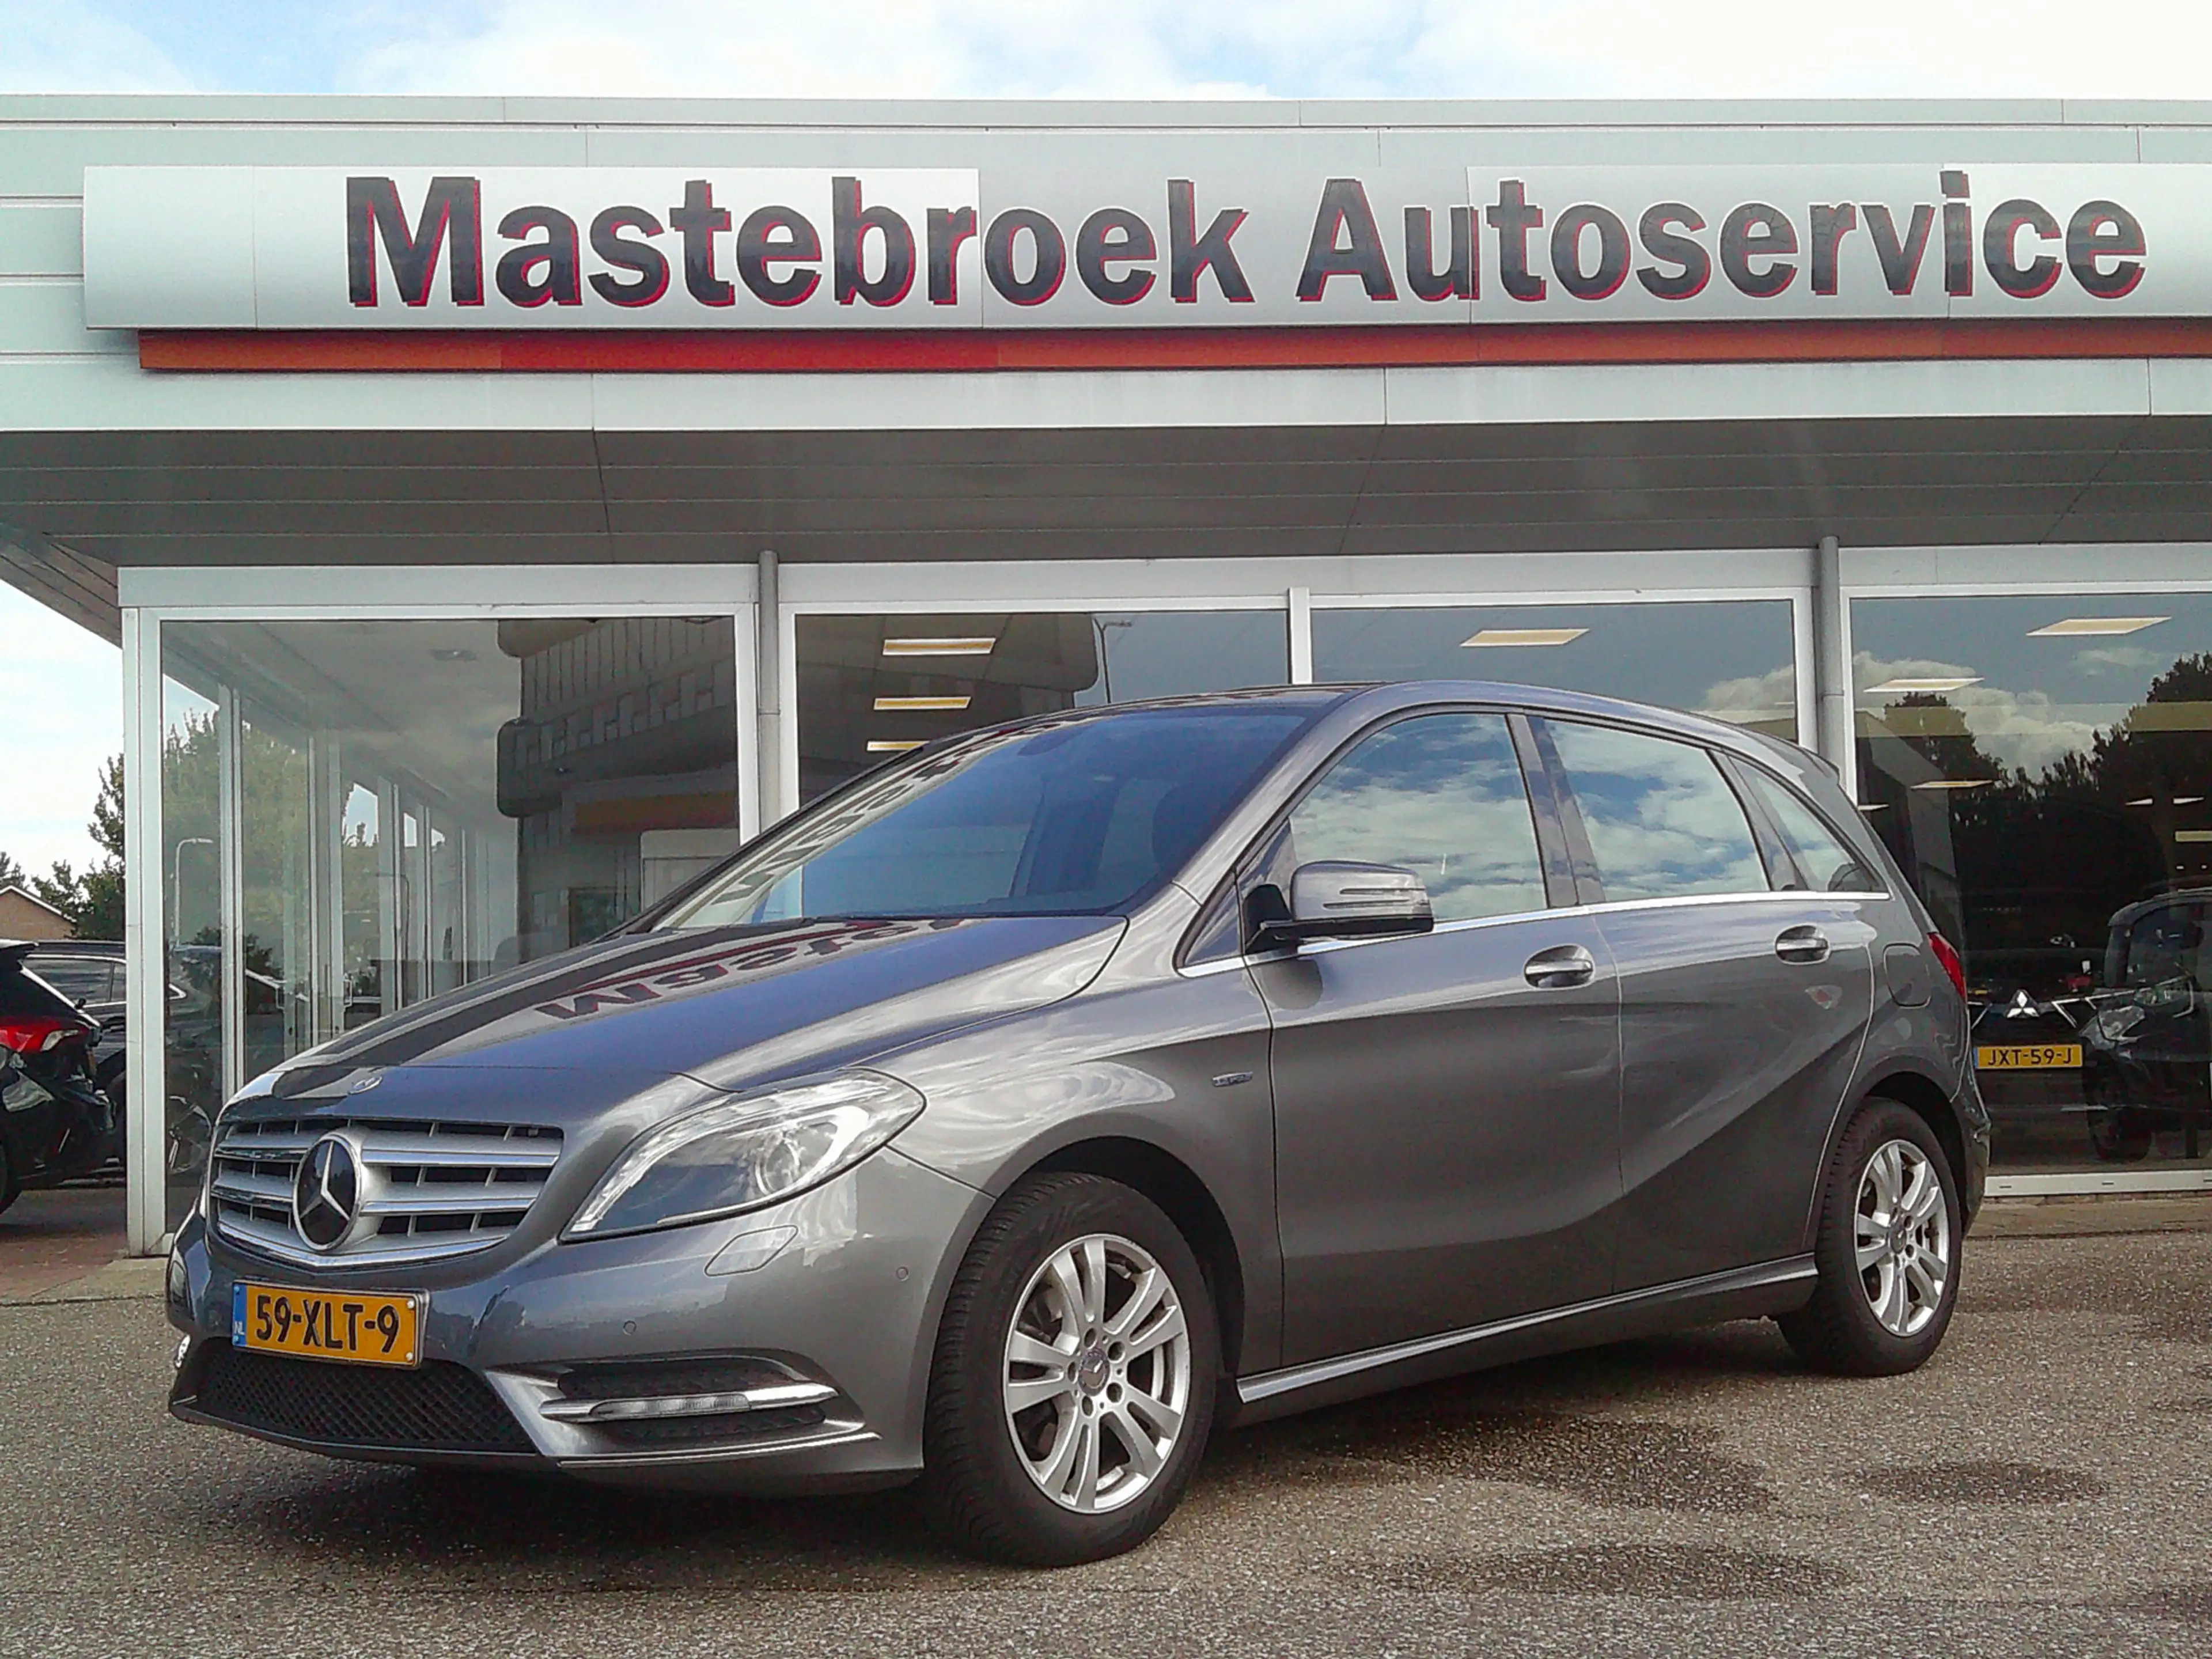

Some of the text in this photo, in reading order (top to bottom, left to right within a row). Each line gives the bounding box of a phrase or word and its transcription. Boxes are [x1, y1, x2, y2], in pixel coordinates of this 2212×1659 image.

[346, 171, 2146, 307] Mastebroek Autoservice
[1988, 1048, 2072, 1066] JXT-59-J
[234, 1321, 245, 1335] NL
[256, 1294, 400, 1354] 59-XLT-9
